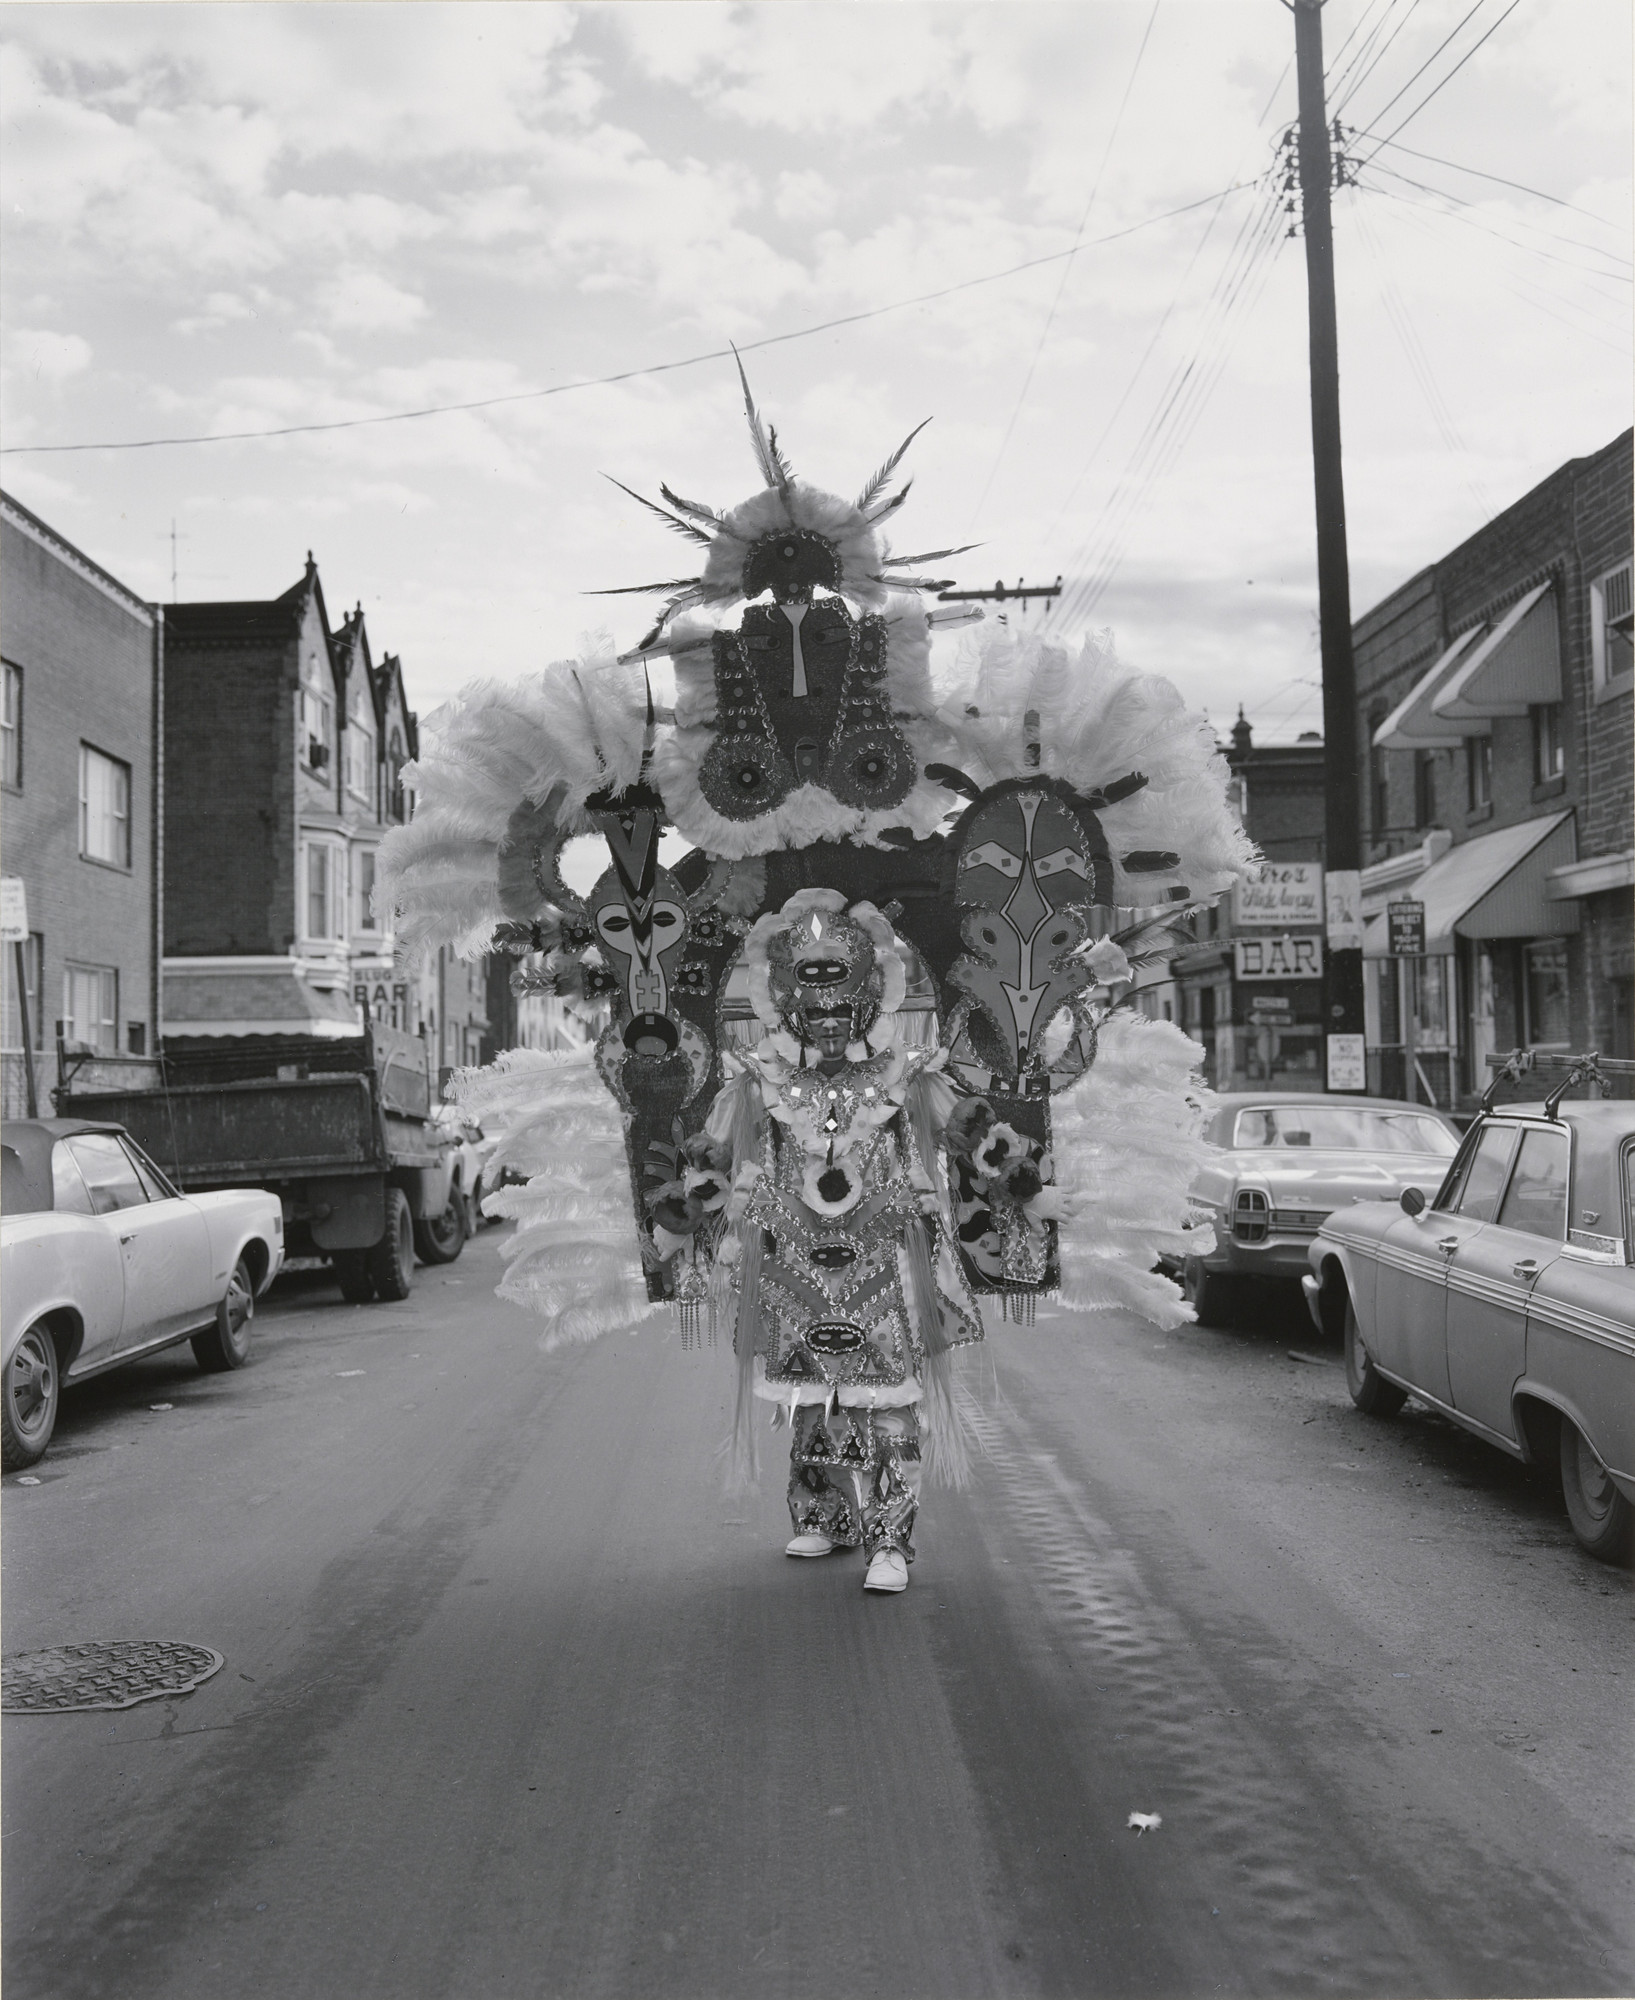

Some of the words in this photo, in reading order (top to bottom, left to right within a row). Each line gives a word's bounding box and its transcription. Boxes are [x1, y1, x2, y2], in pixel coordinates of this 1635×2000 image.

[1402, 925, 1412, 934] TO
[1395, 944, 1420, 953] FINE
[1241, 940, 1318, 974] BAR
[354, 984, 407, 1002] BAR
[1339, 1044, 1353, 1053] NO
